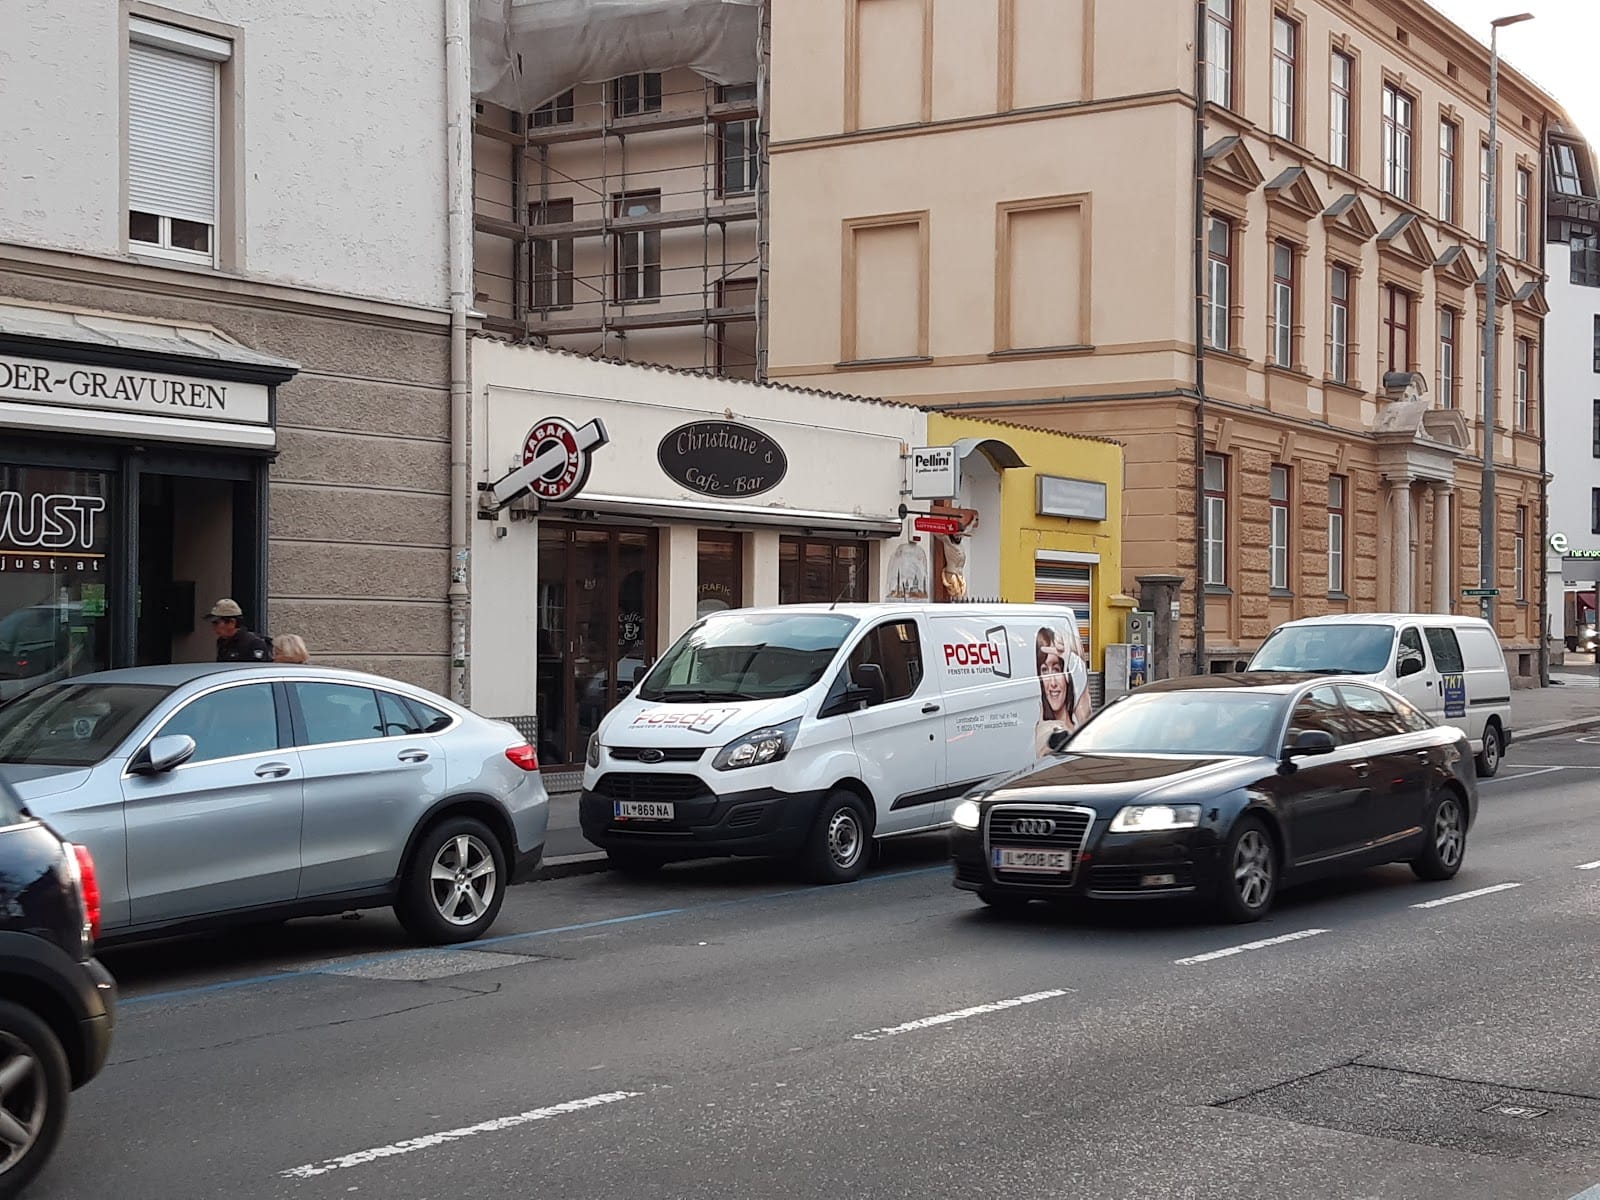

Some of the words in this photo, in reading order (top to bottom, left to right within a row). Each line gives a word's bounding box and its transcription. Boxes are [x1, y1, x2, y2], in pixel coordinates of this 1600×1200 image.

[525, 425, 566, 459] TABAK
[915, 452, 951, 467] Pellini
[733, 476, 764, 492] Bar
[943, 643, 1001, 667] POSCH
[947, 667, 970, 675] FENSTER
[1444, 675, 1462, 688] TKT
[633, 713, 714, 724] POSCH
[622, 803, 631, 815] IL
[637, 804, 655, 816] 869
[656, 805, 669, 816] NA
